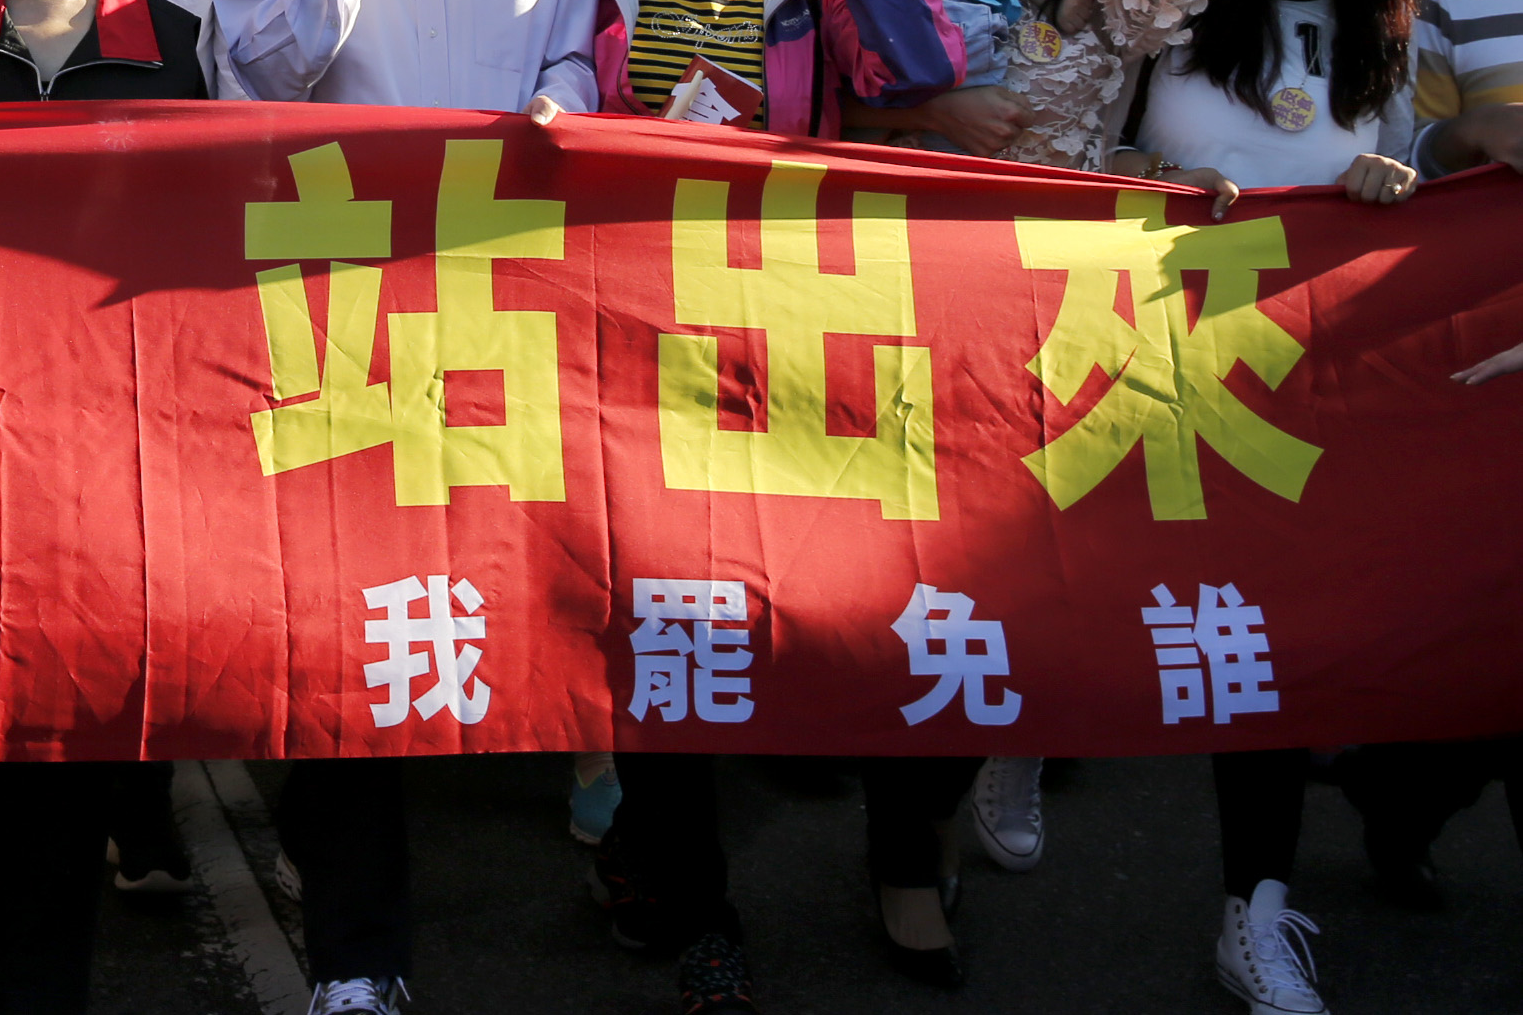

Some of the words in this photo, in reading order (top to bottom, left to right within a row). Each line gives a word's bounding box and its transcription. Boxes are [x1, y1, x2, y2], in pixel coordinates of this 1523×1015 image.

[244, 135, 1324, 522] 站出來
[361, 573, 1281, 729] 我罷免誰
